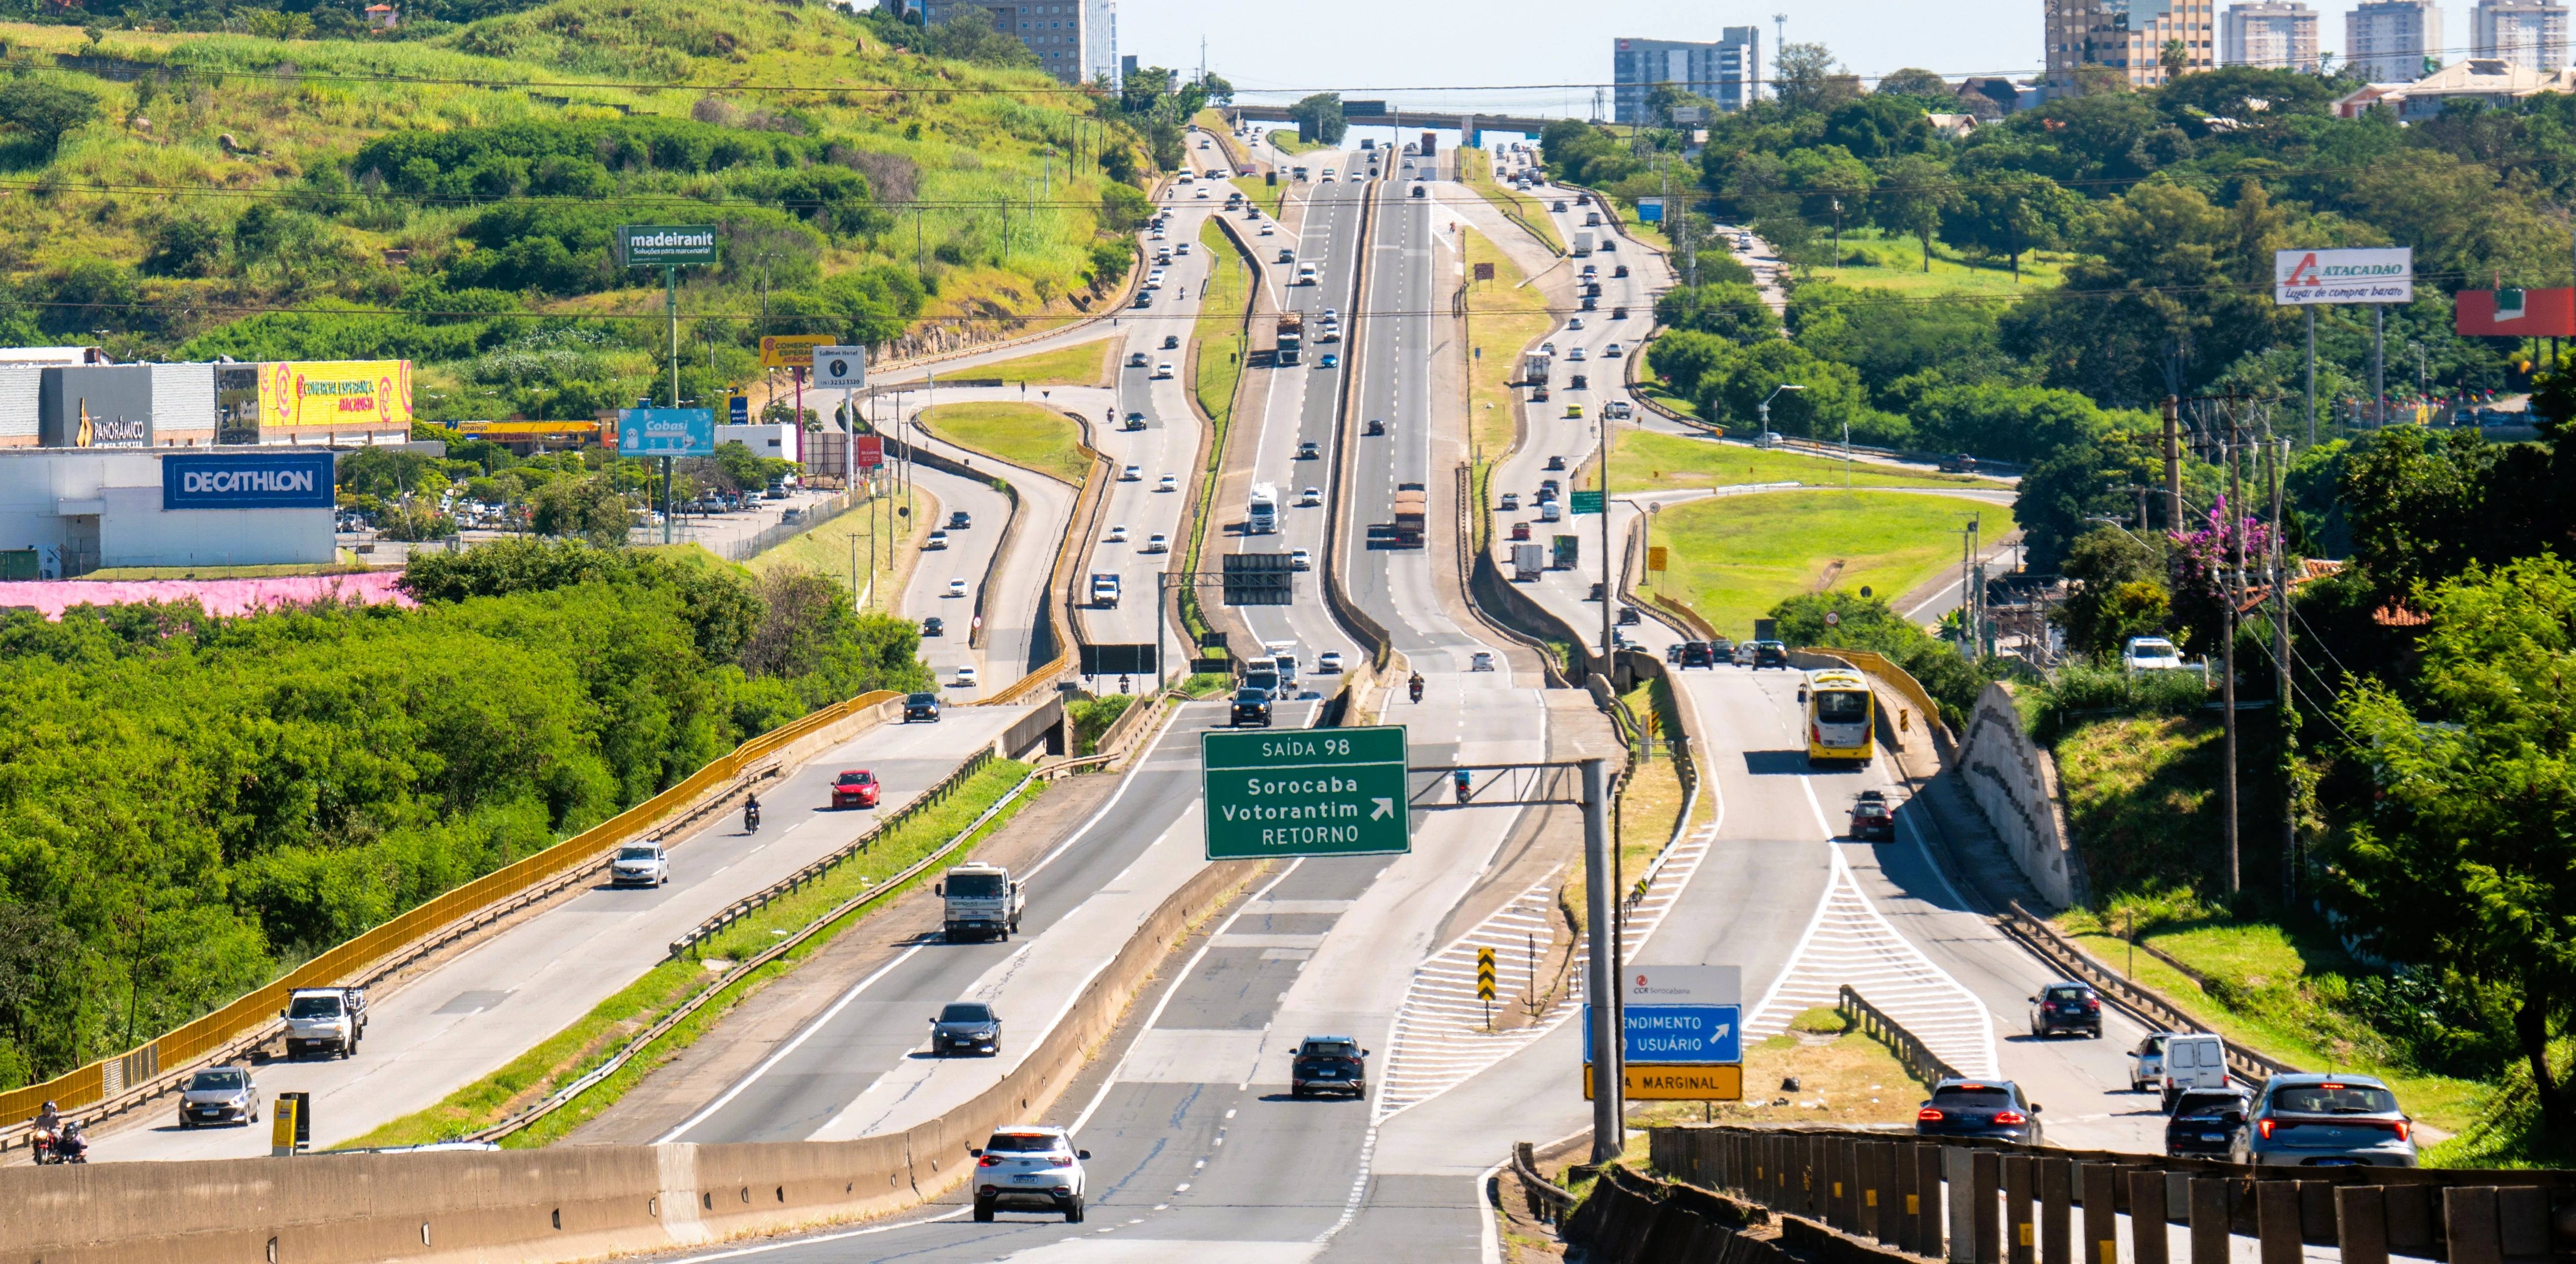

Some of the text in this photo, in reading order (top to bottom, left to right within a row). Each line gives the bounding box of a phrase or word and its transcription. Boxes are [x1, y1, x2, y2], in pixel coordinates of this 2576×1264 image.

[631, 231, 713, 247] madeiranit
[2322, 263, 2403, 276] ATACADÃO
[2285, 285, 2404, 301] Lugar de comprar barato
[304, 380, 374, 396] COMERCIAL ESPERANÇA
[339, 396, 375, 412] ATACADISTA
[94, 415, 144, 440] PANORÂMICO
[646, 420, 688, 431] Cobasi
[184, 470, 313, 492] DECATHLON
[1262, 737, 1350, 757] SAÍDA 98
[1248, 776, 1358, 796] Sorocaba
[1222, 801, 1358, 822] Votorantim
[1262, 826, 1359, 845] RETORNO
[1638, 1035, 1702, 1051] USUÁRIO
[1643, 1076, 1718, 1089] MARGINAL
